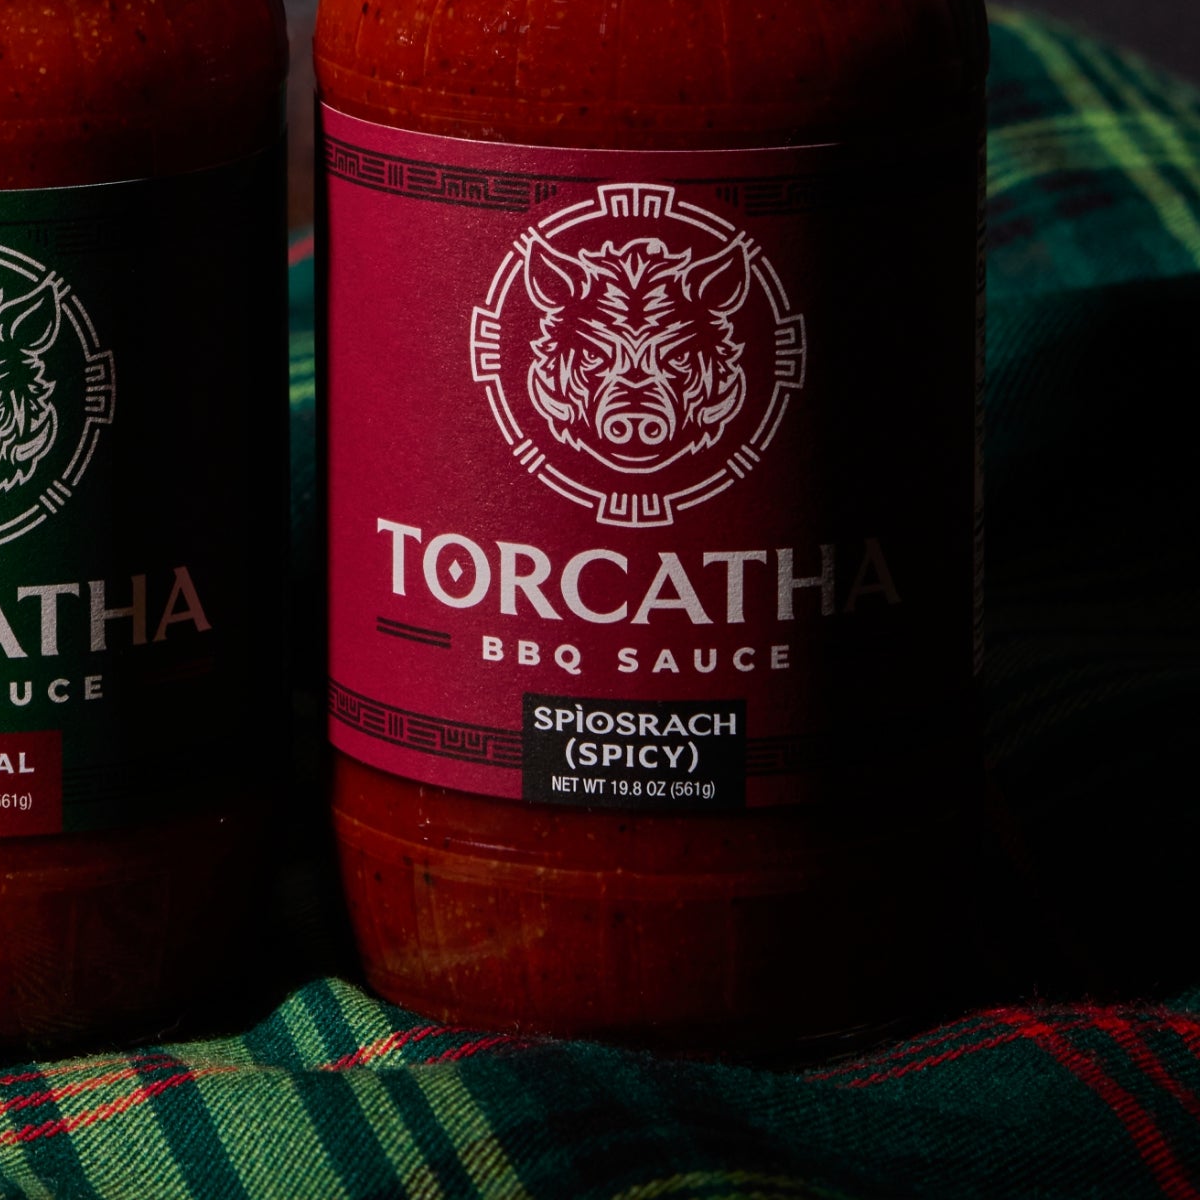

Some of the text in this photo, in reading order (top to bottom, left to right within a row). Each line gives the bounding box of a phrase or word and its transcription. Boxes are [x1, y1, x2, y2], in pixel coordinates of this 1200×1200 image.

[377, 517, 901, 626] TORCATHA
[481, 635, 791, 675] BBQ SAUCE
[565, 737, 700, 774] (SPICY)
[552, 775, 716, 800] NET WT 19.8 OZ (561g)
